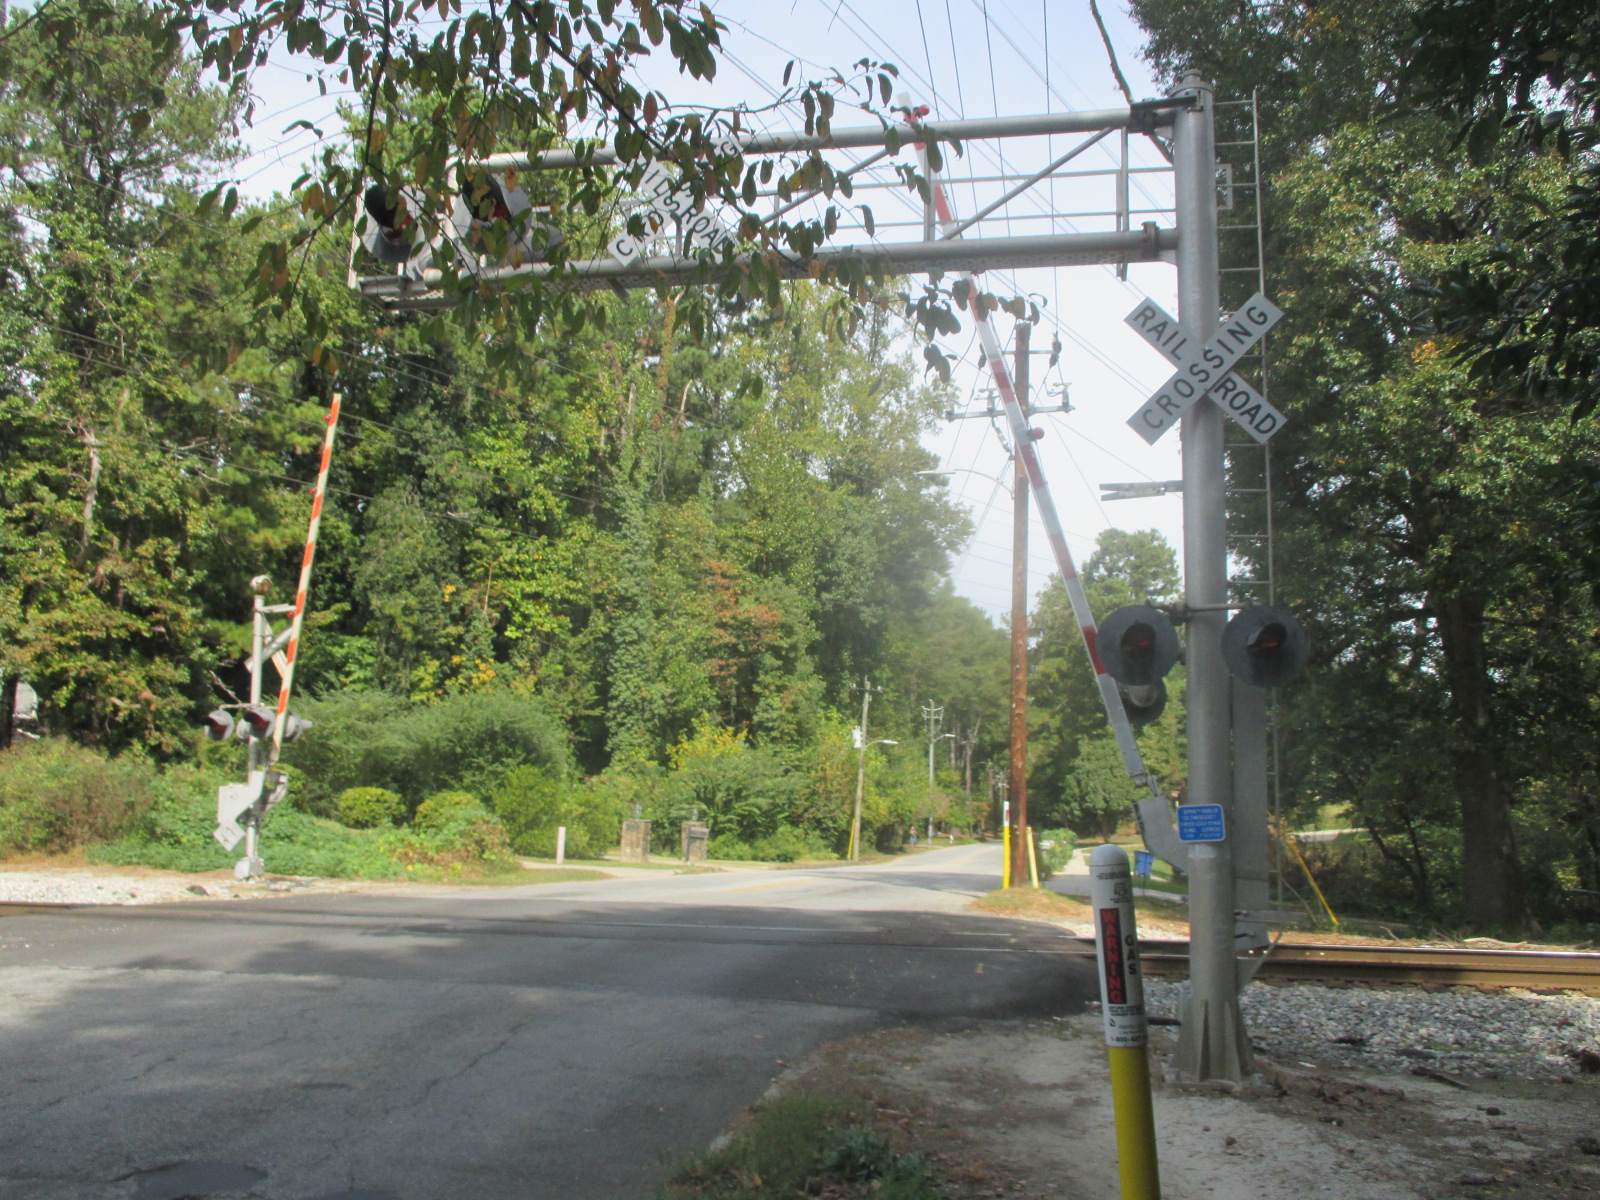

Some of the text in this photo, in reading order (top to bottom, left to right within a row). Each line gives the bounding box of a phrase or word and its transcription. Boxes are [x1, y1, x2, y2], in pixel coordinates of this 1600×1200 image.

[1133, 305, 1187, 361] RAIL
[1142, 306, 1268, 429] CROSSING
[1214, 376, 1277, 434] ROAD
[1102, 910, 1122, 1003] WARNING
[1125, 934, 1137, 974] GAS
